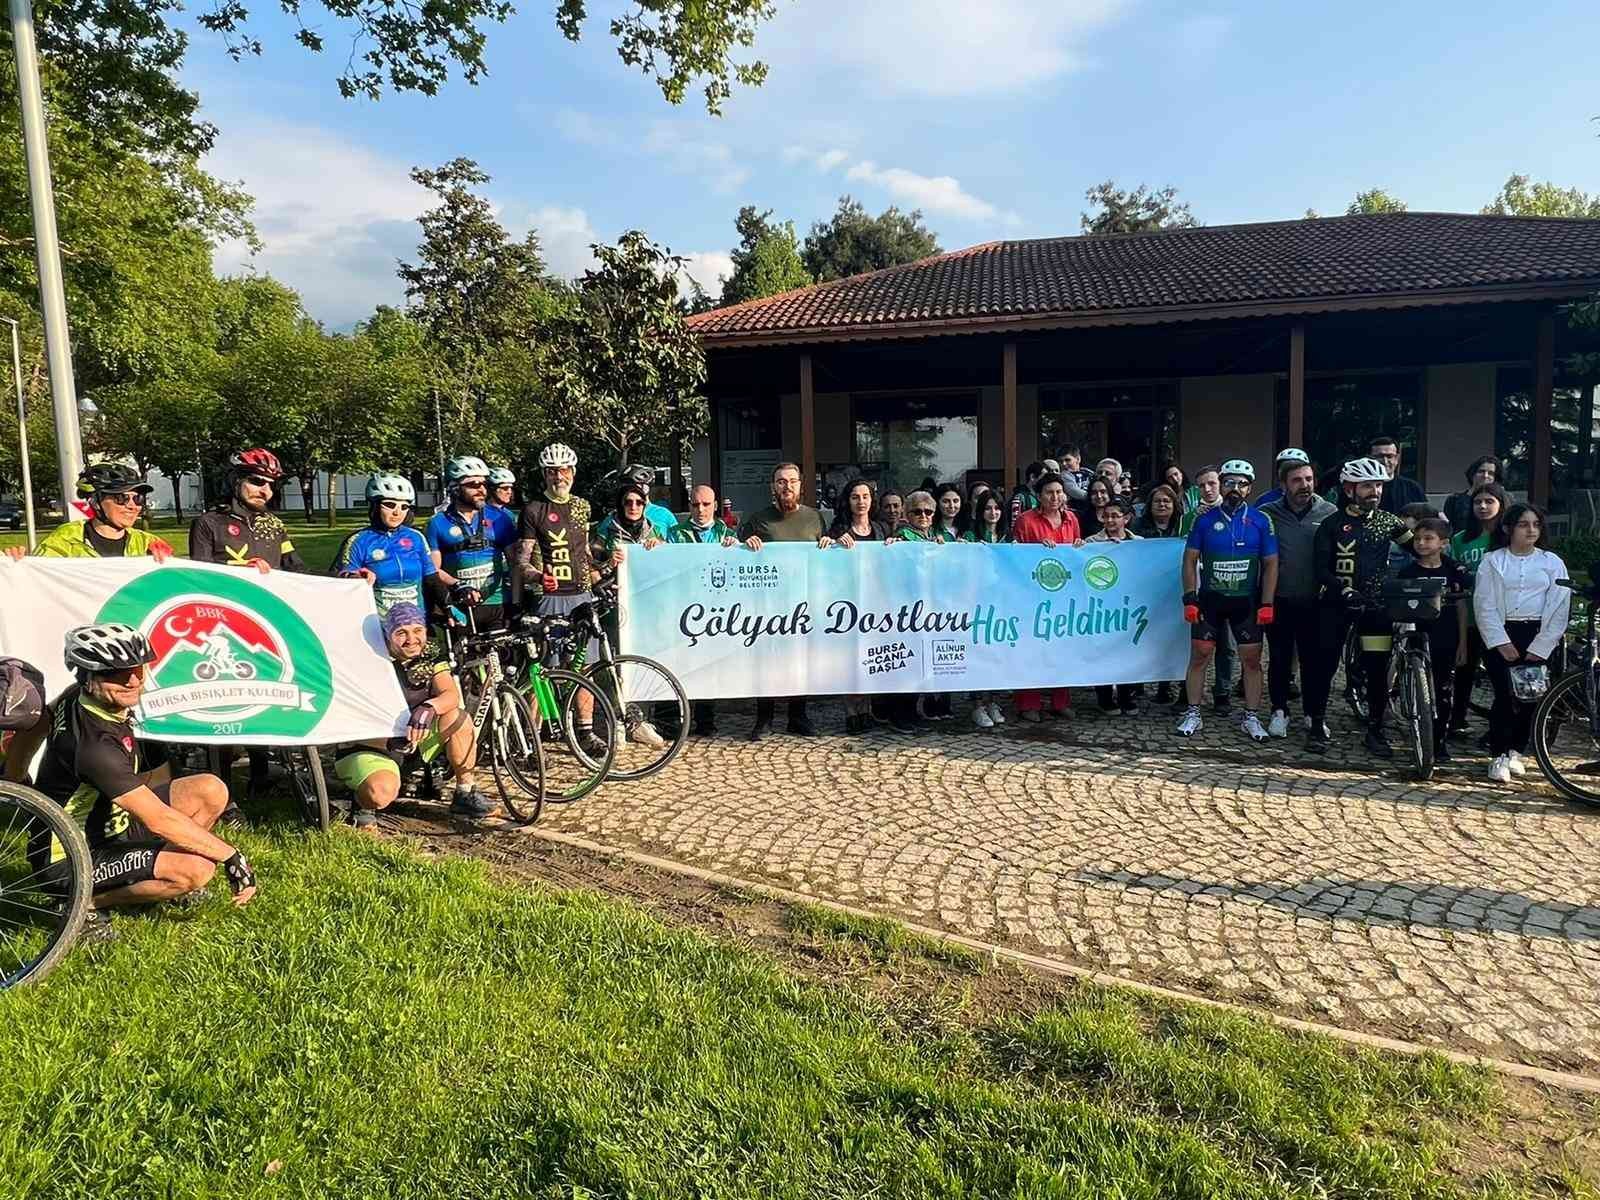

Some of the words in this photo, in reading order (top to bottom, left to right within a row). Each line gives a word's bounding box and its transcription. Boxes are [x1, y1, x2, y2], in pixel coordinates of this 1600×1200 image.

[548, 528, 572, 581] BBK
[738, 565, 778, 574] BURSA
[195, 606, 228, 621] BBK
[680, 602, 813, 647] Çölyak
[824, 599, 971, 634] Dostları
[968, 604, 1020, 648] Hoş
[1033, 595, 1149, 645] Geldiniz
[867, 642, 906, 657] BURSA
[875, 649, 915, 664] CANLA
[869, 660, 907, 675] BAŞLA
[148, 694, 188, 709] BURSA
[473, 690, 491, 728] GIANT
[212, 723, 243, 735] 2017
